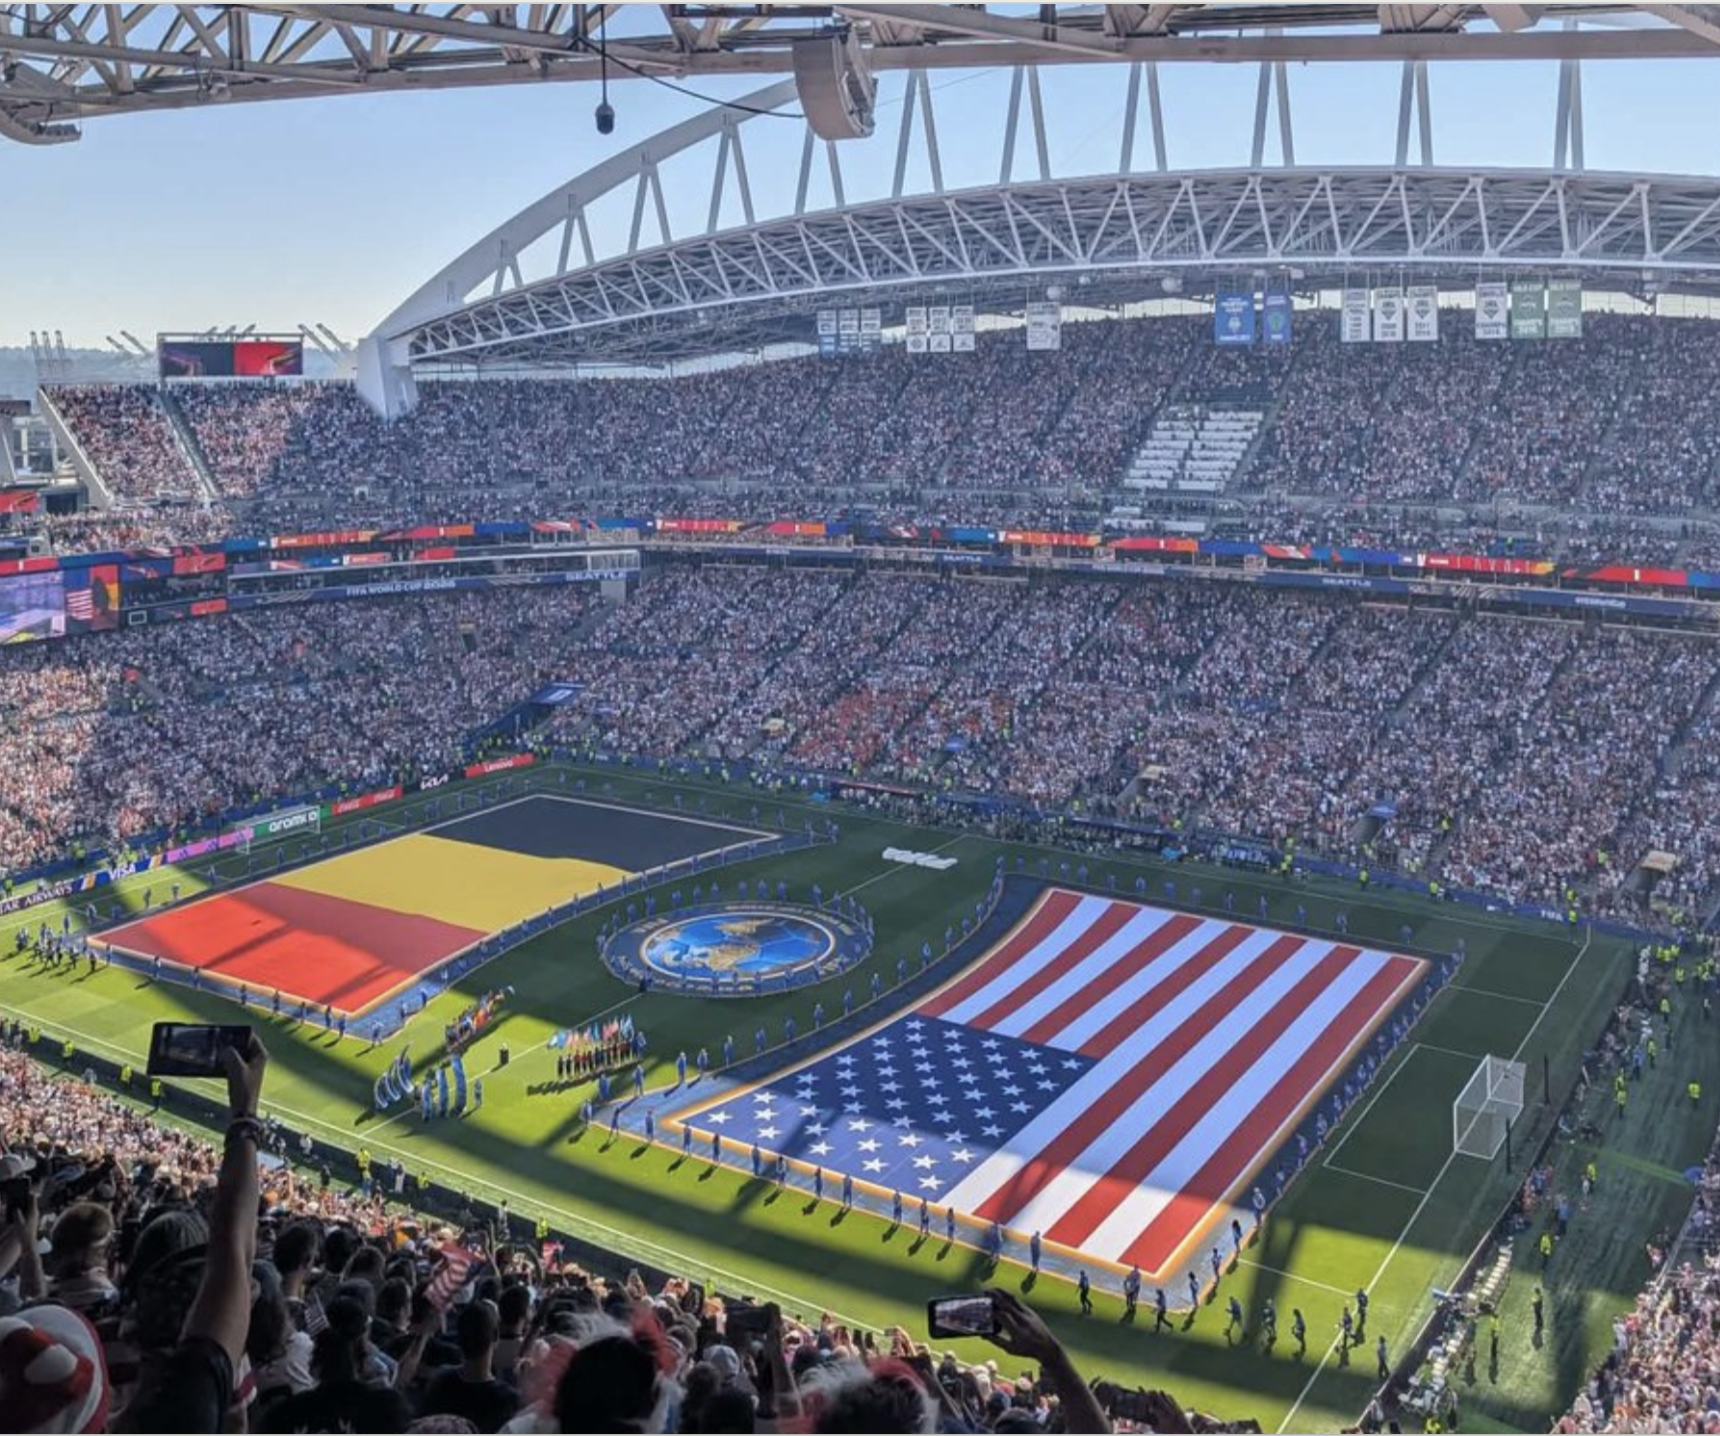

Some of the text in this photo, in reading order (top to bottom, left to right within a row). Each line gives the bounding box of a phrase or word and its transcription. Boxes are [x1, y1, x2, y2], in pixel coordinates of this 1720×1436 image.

[346, 585, 367, 597] FIFA
[368, 582, 402, 594] WORLD
[404, 581, 421, 592] CUP
[108, 863, 136, 881] VISA
[25, 884, 73, 905] AIRWAYS
